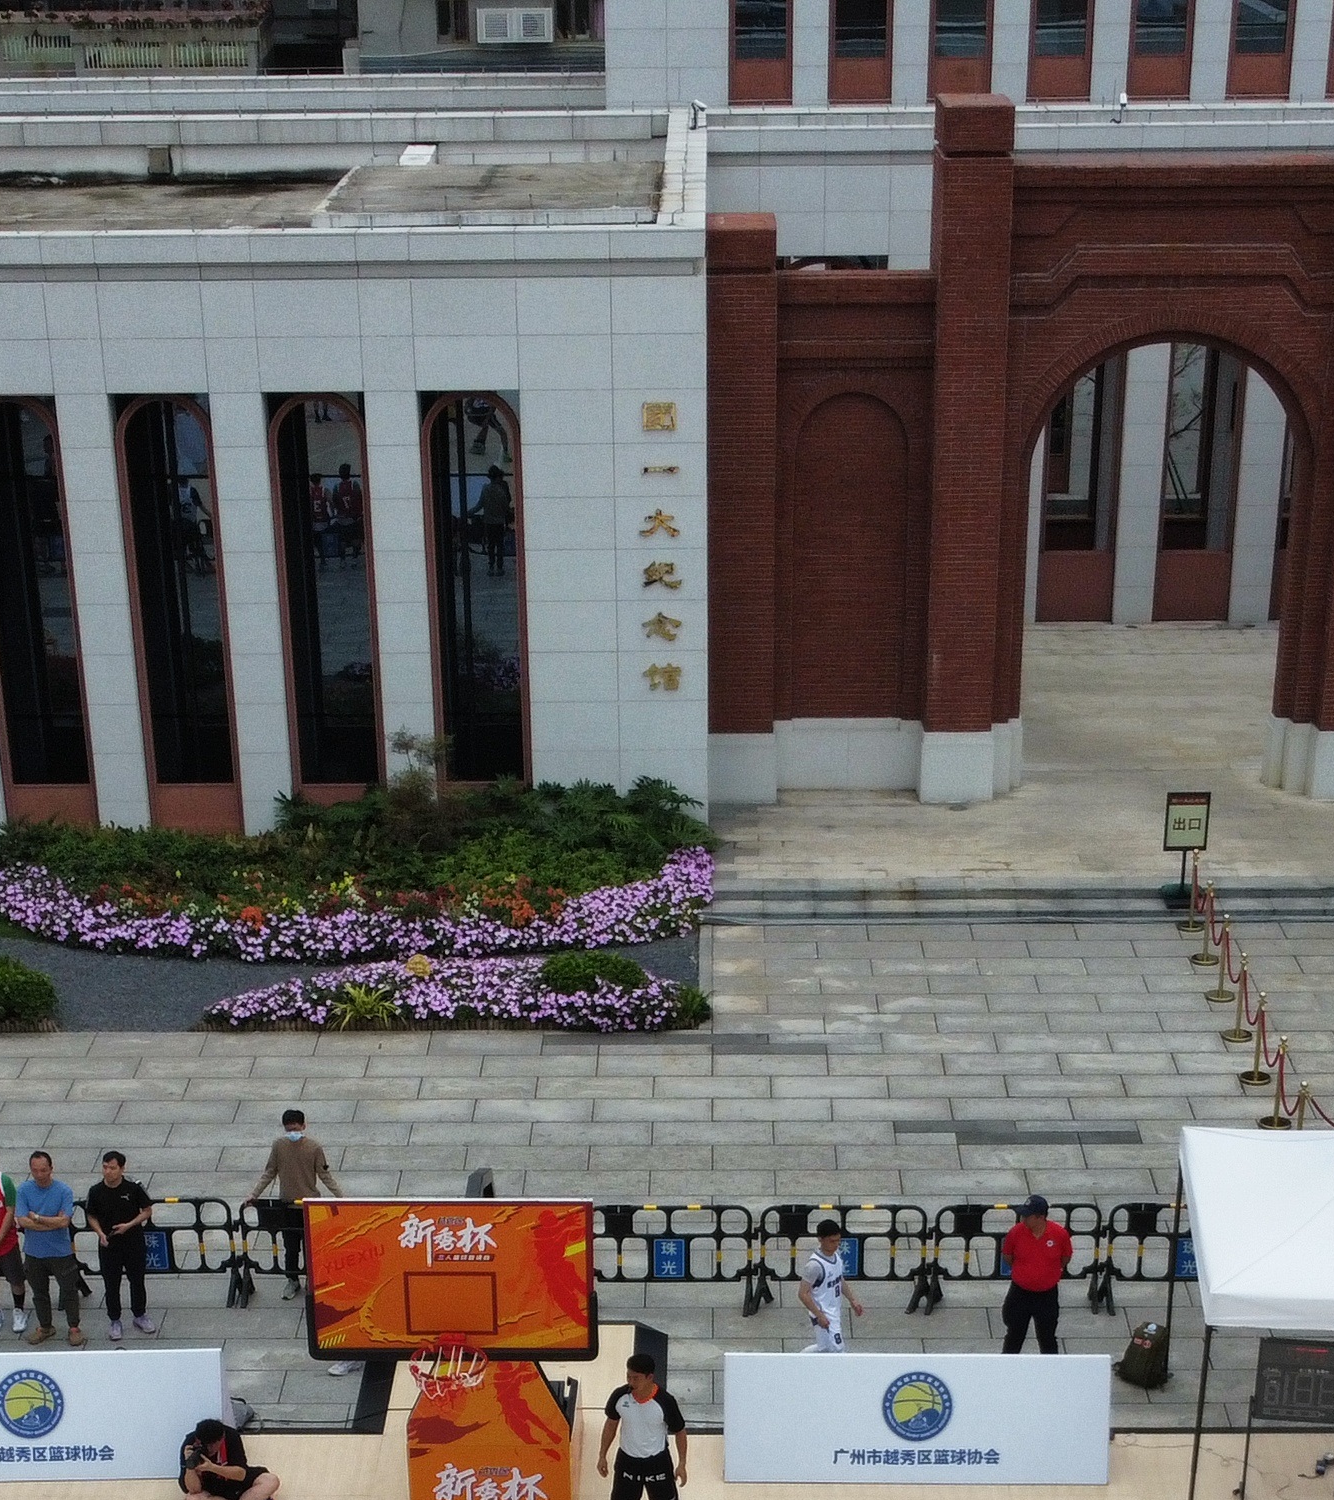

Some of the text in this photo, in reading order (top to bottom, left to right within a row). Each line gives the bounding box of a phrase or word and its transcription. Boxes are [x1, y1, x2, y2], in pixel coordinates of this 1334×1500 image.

[1172, 817, 1201, 831] 出口
[397, 1213, 498, 1267] 新秀杯
[322, 1245, 385, 1275] YUEXIU
[661, 1241, 677, 1275] 珠光
[833, 1448, 1000, 1465] 广州市越秀区篮球协会
[622, 1471, 667, 1482] NIKE
